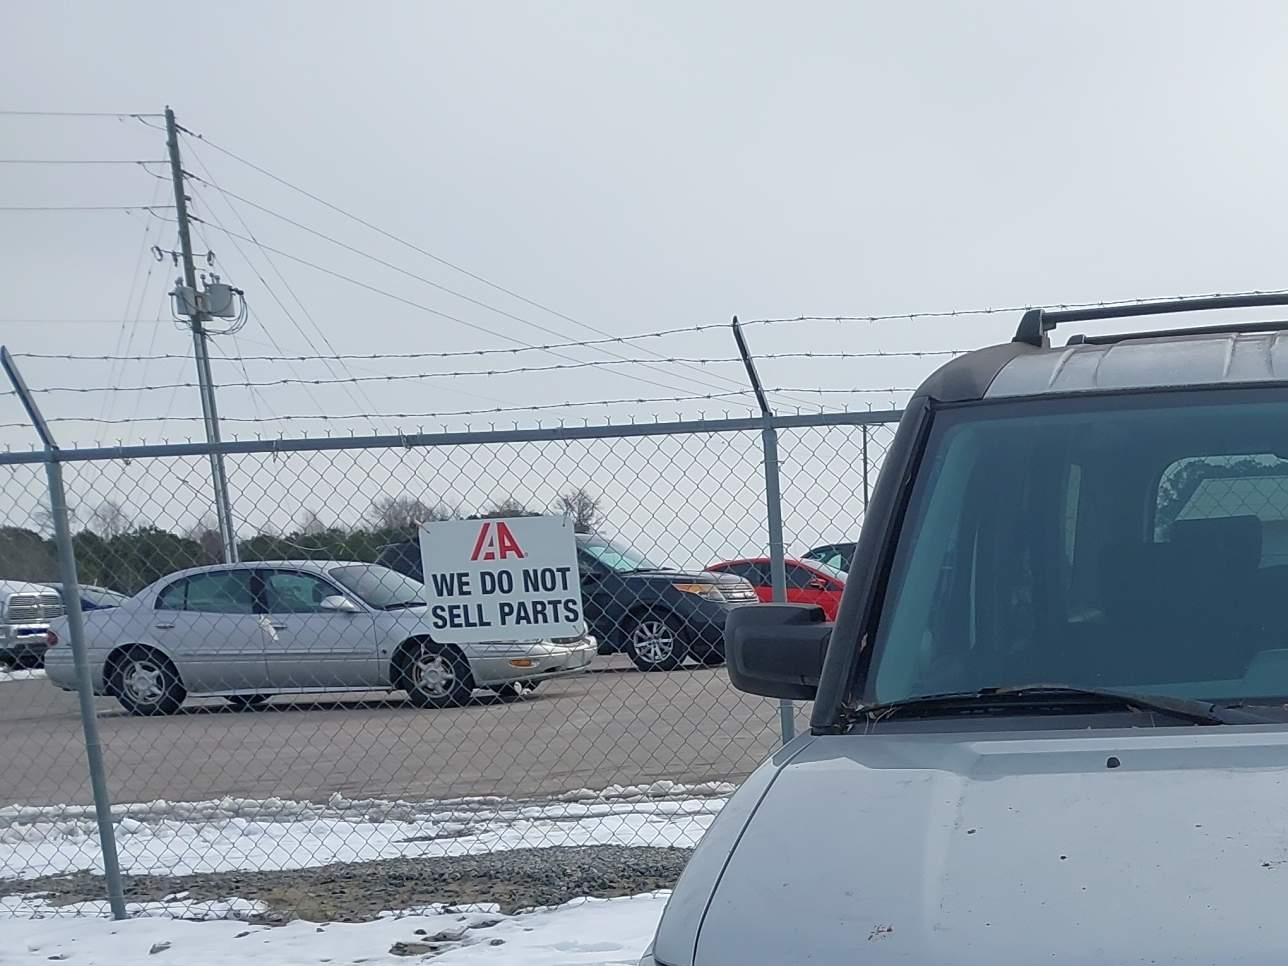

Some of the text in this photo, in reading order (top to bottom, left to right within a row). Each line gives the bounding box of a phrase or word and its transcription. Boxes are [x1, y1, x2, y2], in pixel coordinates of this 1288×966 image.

[431, 567, 571, 597] WE DO NOT
[431, 598, 579, 629] SELL PARTS
